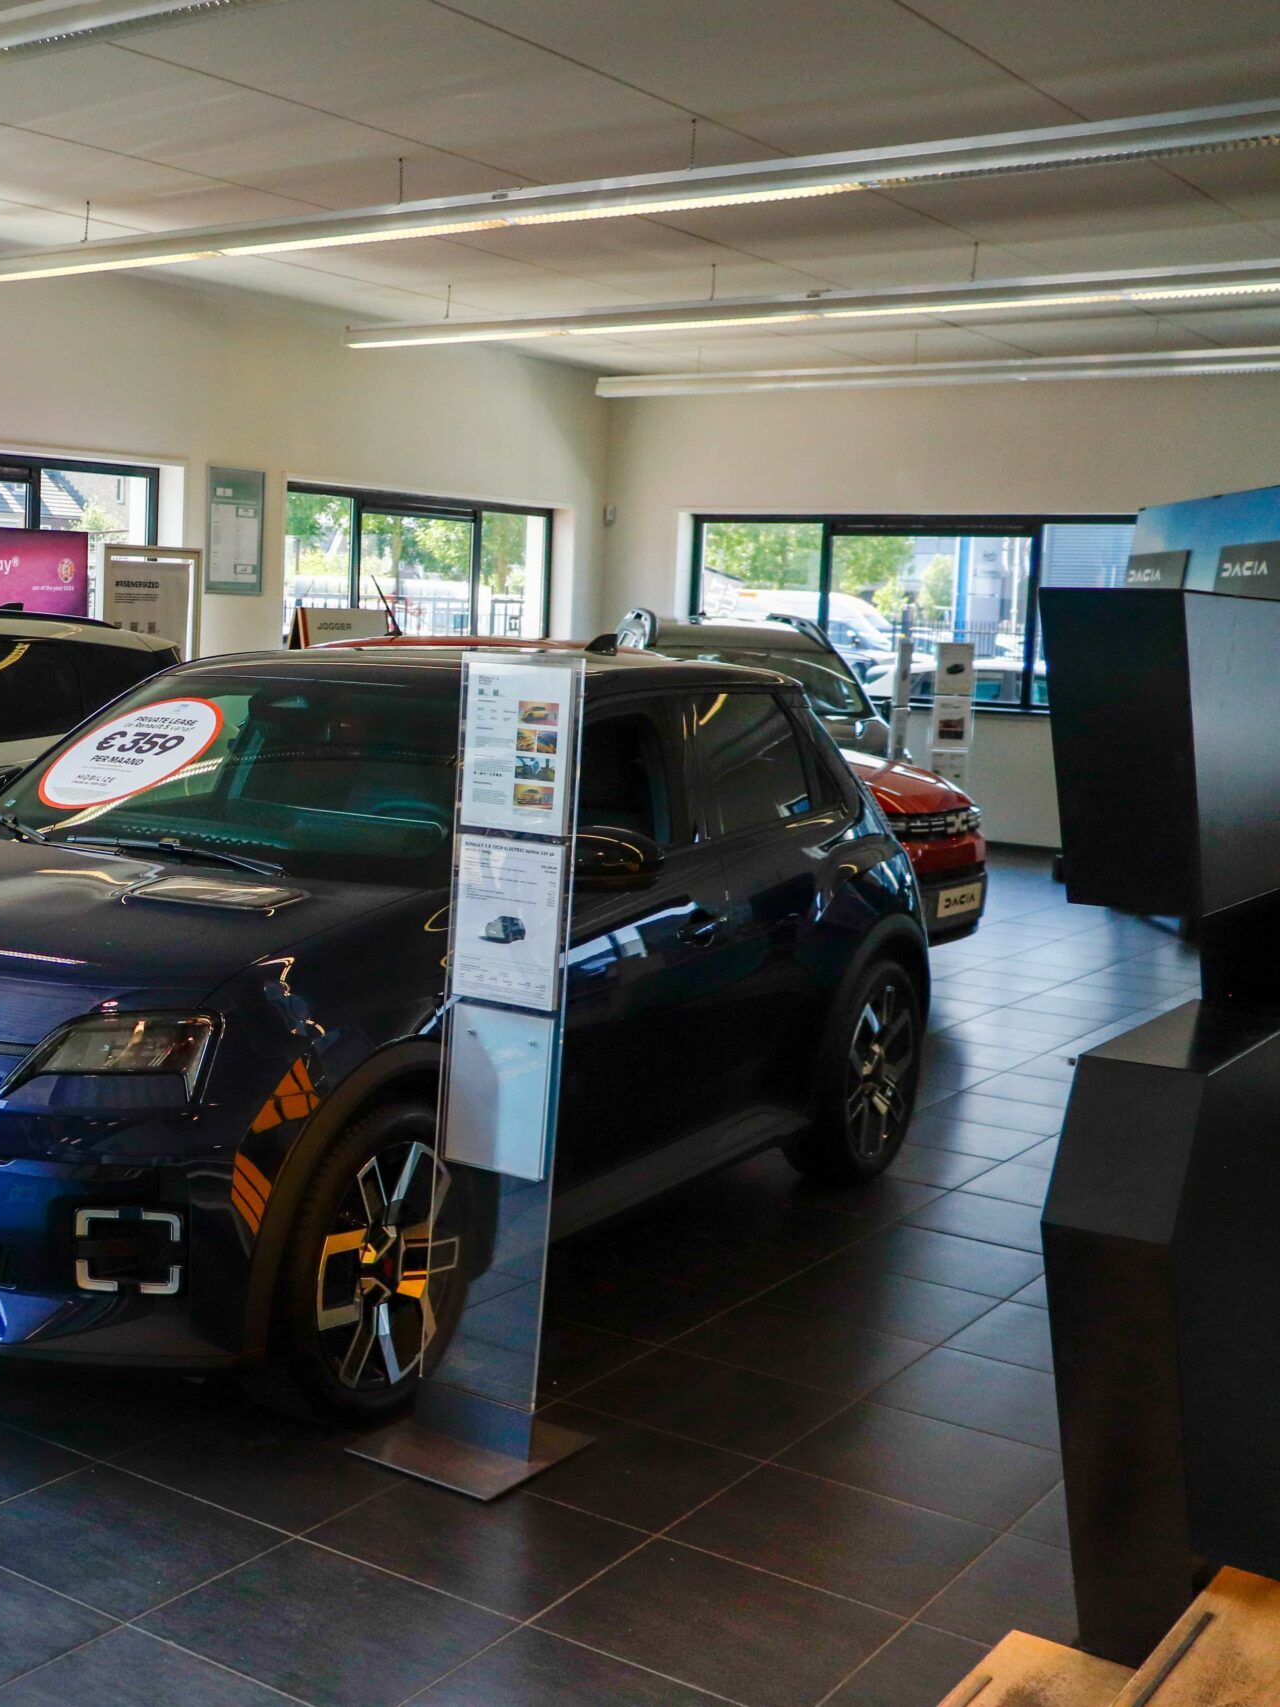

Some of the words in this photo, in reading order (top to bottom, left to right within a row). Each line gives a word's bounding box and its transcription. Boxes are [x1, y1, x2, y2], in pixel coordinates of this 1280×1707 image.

[1127, 568, 1161, 583] DACIA
[1221, 560, 1269, 578] DACIA
[317, 622, 352, 631] JOGGER
[169, 718, 198, 726] LEASE
[96, 731, 128, 751] €
[117, 732, 185, 756] 359
[90, 755, 110, 763] PER
[108, 756, 144, 766] MAAND
